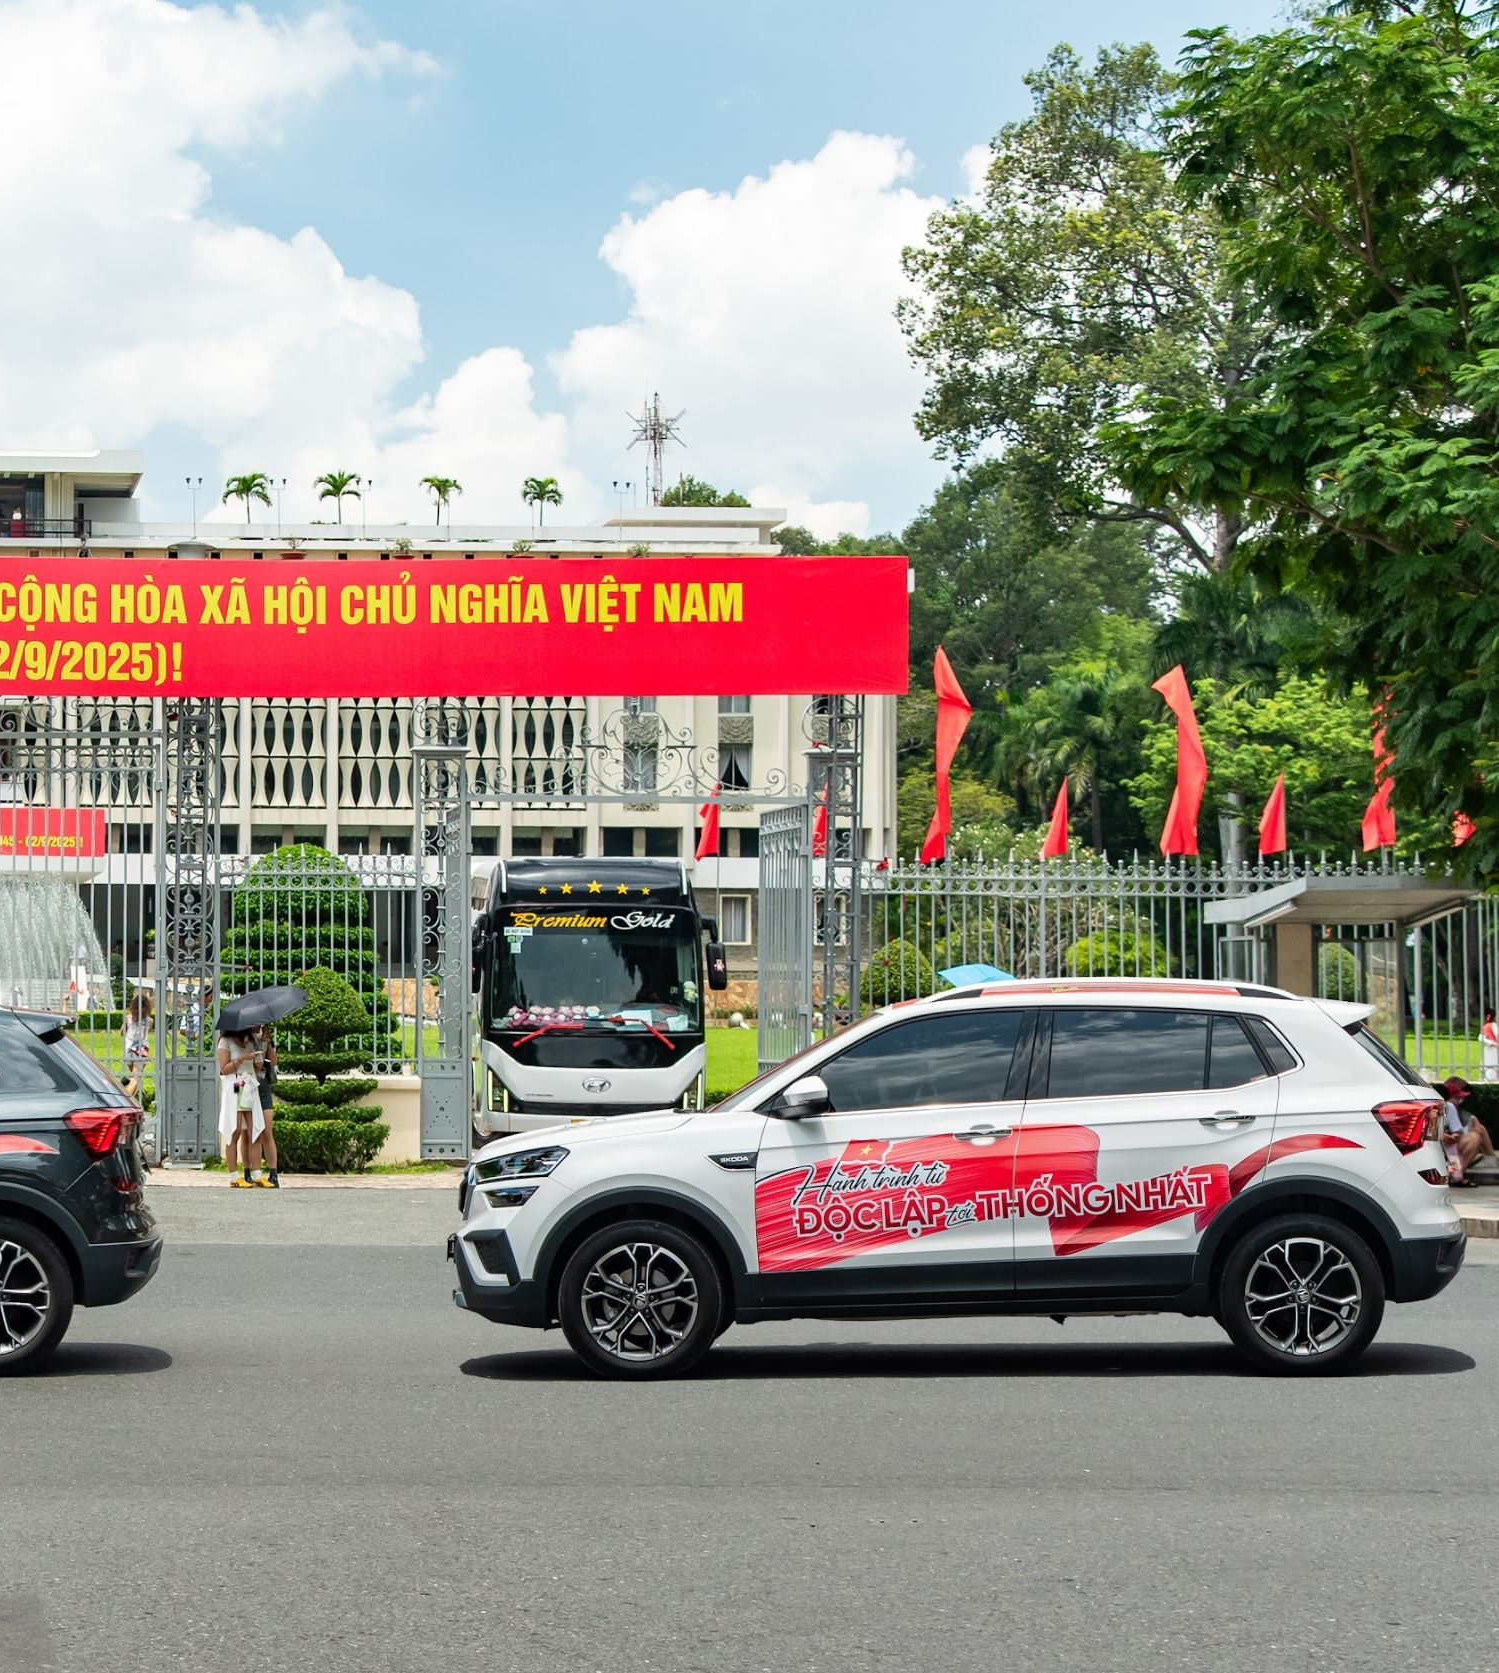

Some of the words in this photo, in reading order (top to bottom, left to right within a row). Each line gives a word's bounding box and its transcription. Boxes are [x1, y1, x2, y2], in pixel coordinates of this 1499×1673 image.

[110, 574, 188, 625] HÒA
[199, 576, 252, 625] XÃ
[263, 576, 327, 634] HỘI
[339, 571, 417, 625] CHỦ
[429, 575, 549, 625] NGHĨA
[560, 574, 642, 632] VIỆT
[653, 582, 743, 623] NAM
[510, 911, 608, 929] Premium
[610, 911, 675, 931] Gold
[793, 1195, 876, 1241] ĐỘC
[882, 1189, 948, 1237] LẬP
[976, 1174, 1111, 1220] THỐNG
[1115, 1166, 1212, 1213] NHẤT
